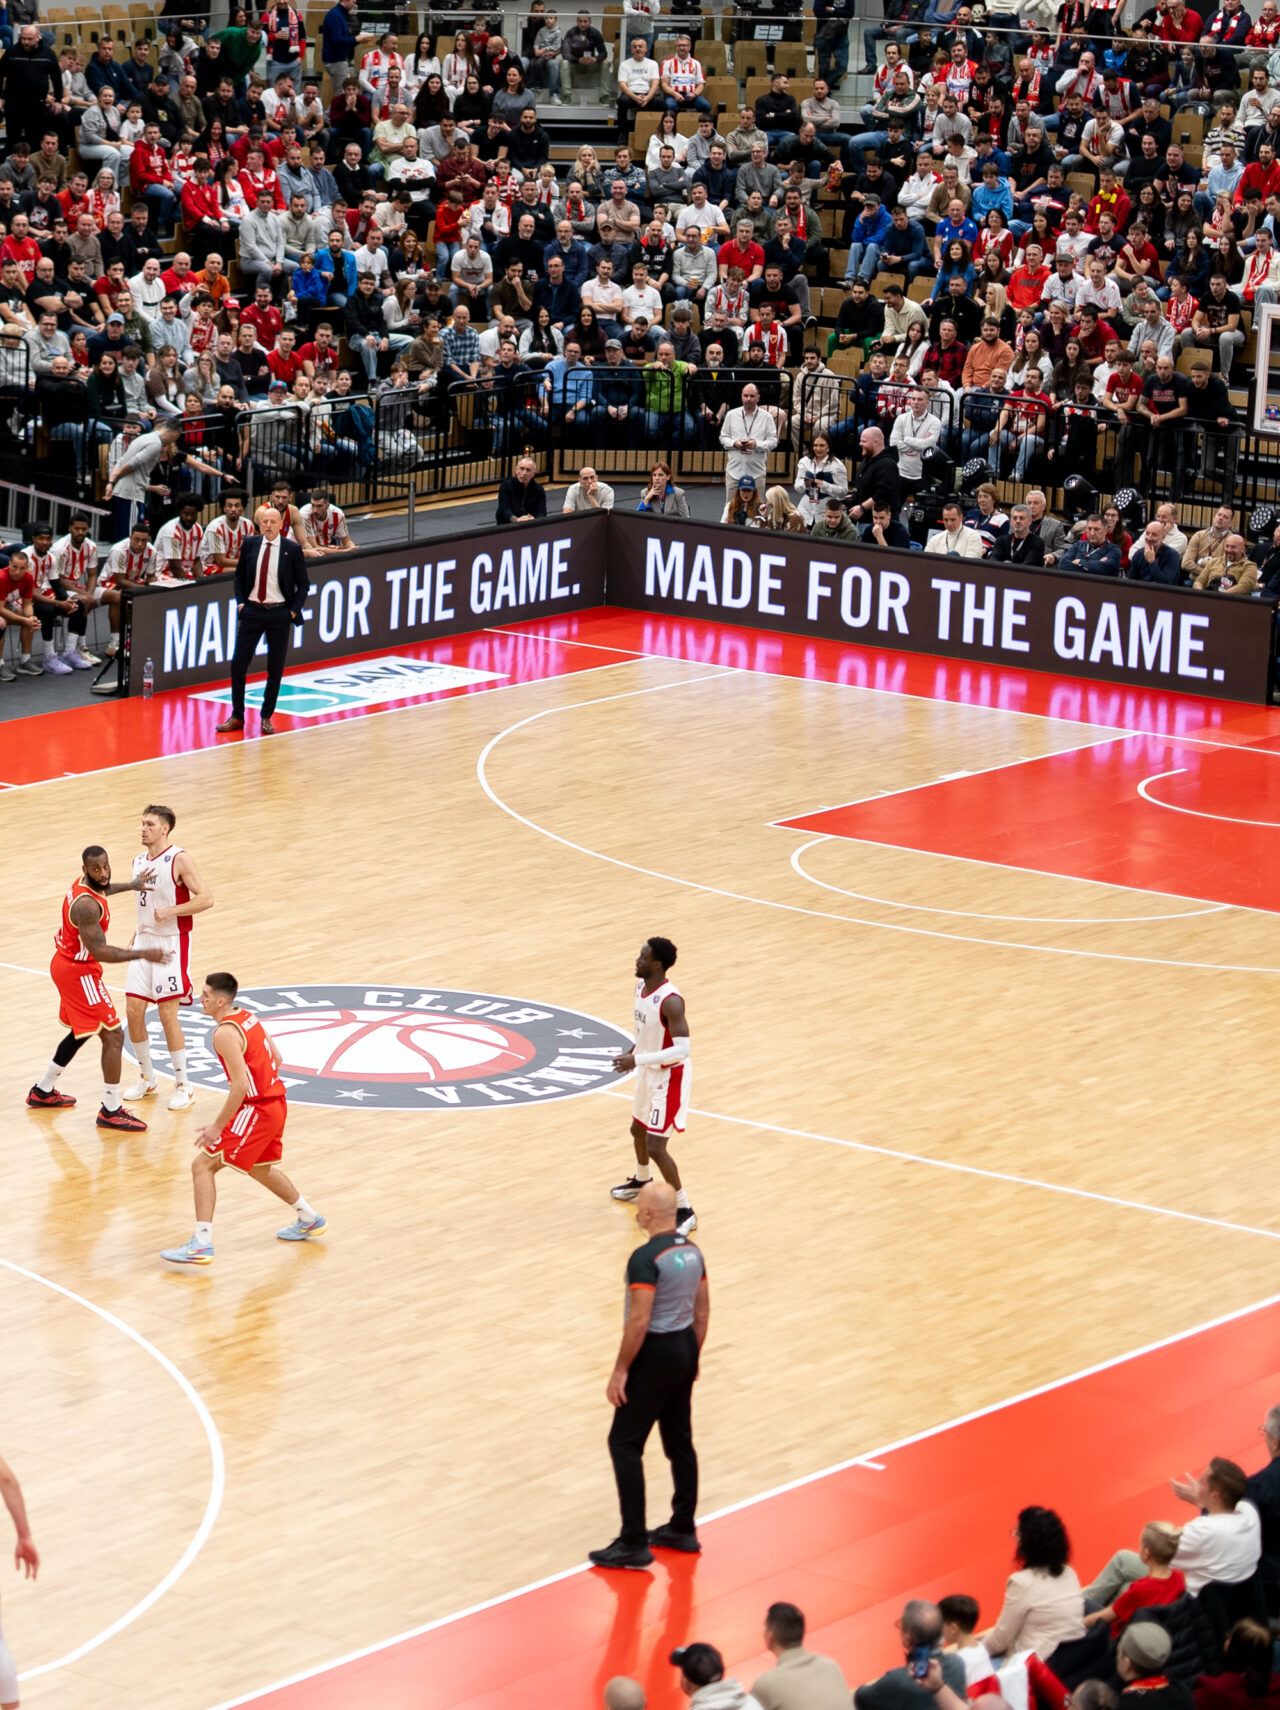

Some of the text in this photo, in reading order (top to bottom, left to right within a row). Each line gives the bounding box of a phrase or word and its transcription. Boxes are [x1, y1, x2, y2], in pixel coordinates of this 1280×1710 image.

[163, 597, 269, 673] MA
[386, 559, 456, 630] THE
[470, 538, 580, 615] GAME.
[645, 537, 1225, 681] MADE FOR THE GAME.
[313, 662, 444, 688] SAVA
[139, 891, 147, 907] 3
[168, 976, 178, 992] 3
[363, 991, 555, 1025] CLUB
[415, 1046, 623, 1104] VIENNA
